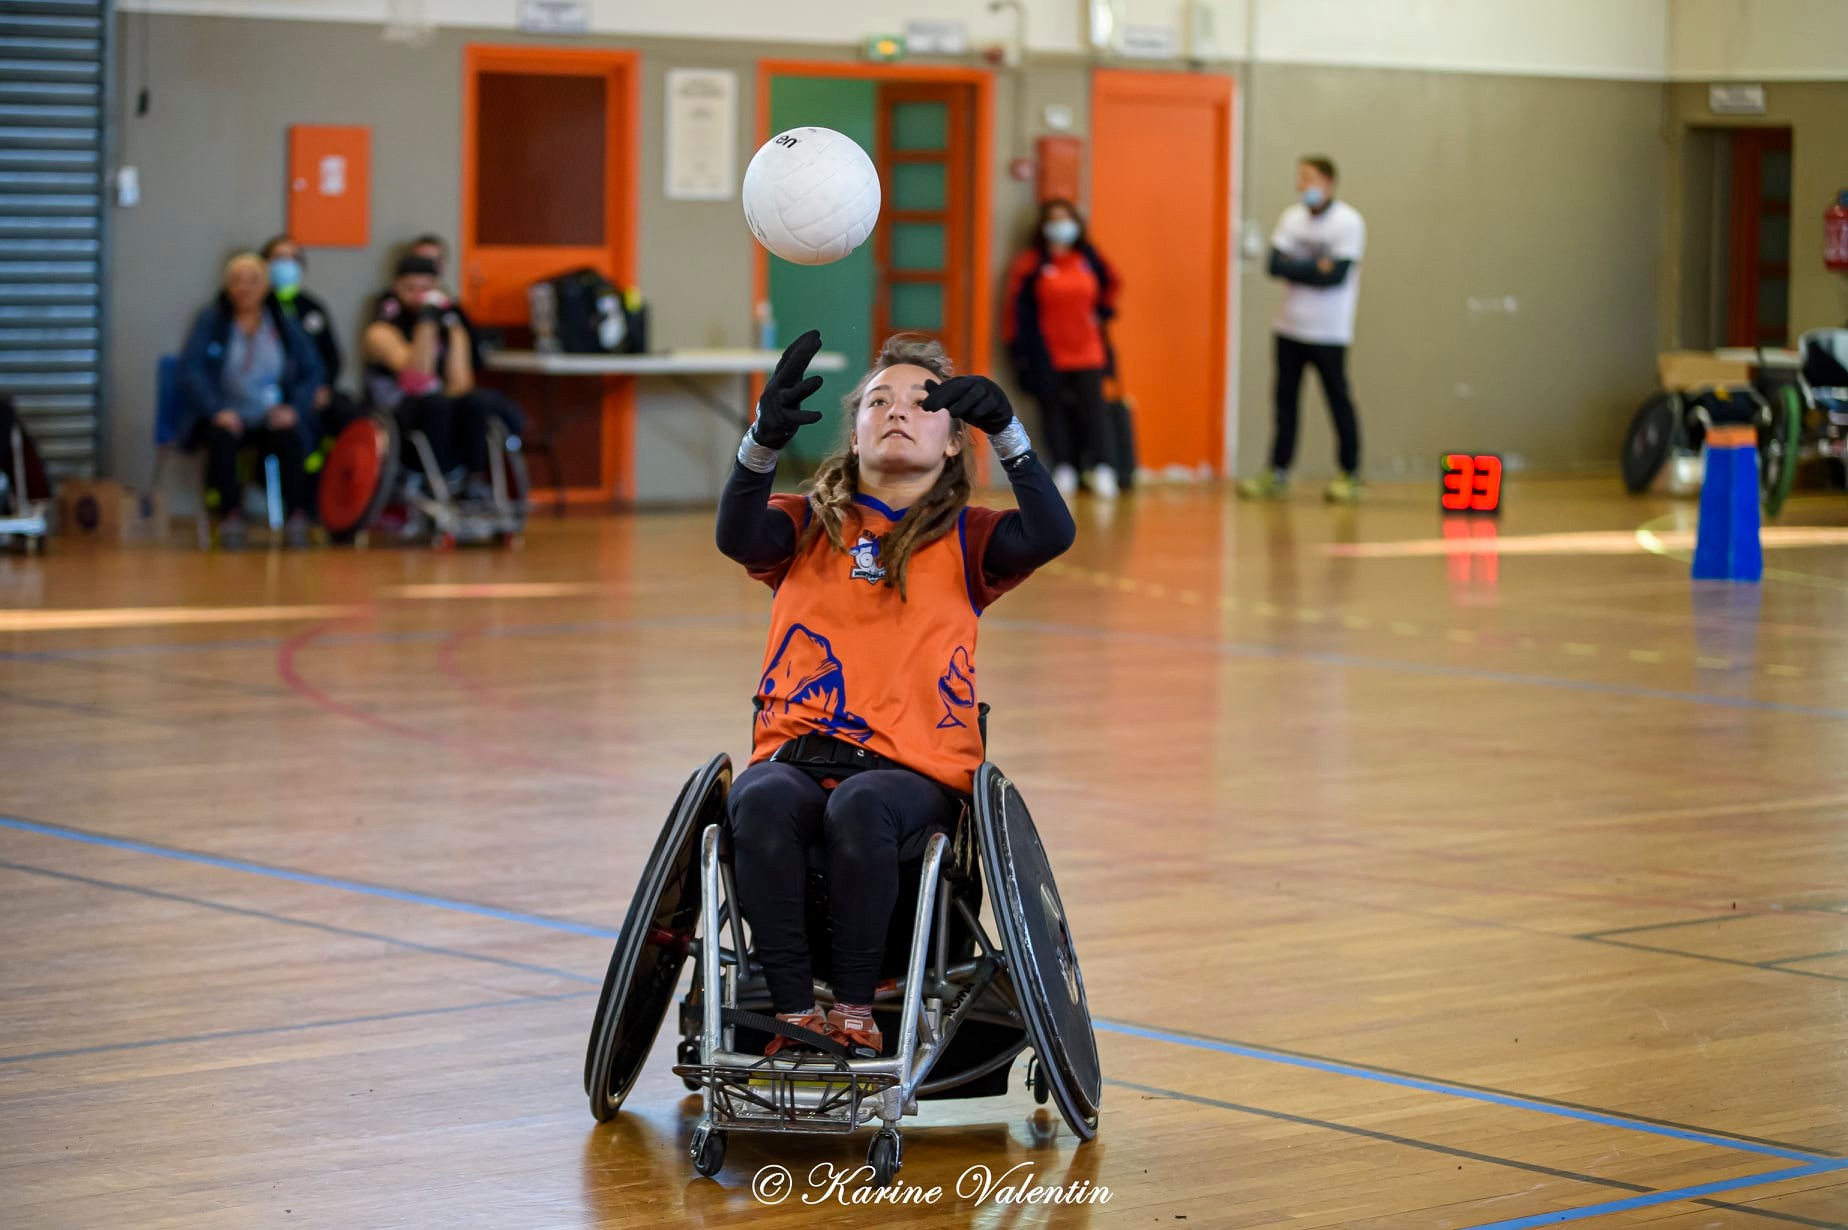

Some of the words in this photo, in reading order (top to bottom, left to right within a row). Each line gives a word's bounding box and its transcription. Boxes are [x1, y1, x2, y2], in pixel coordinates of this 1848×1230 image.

[774, 134, 798, 149] en
[1441, 454, 1502, 510] 33
[943, 983, 975, 1017] ROMA
